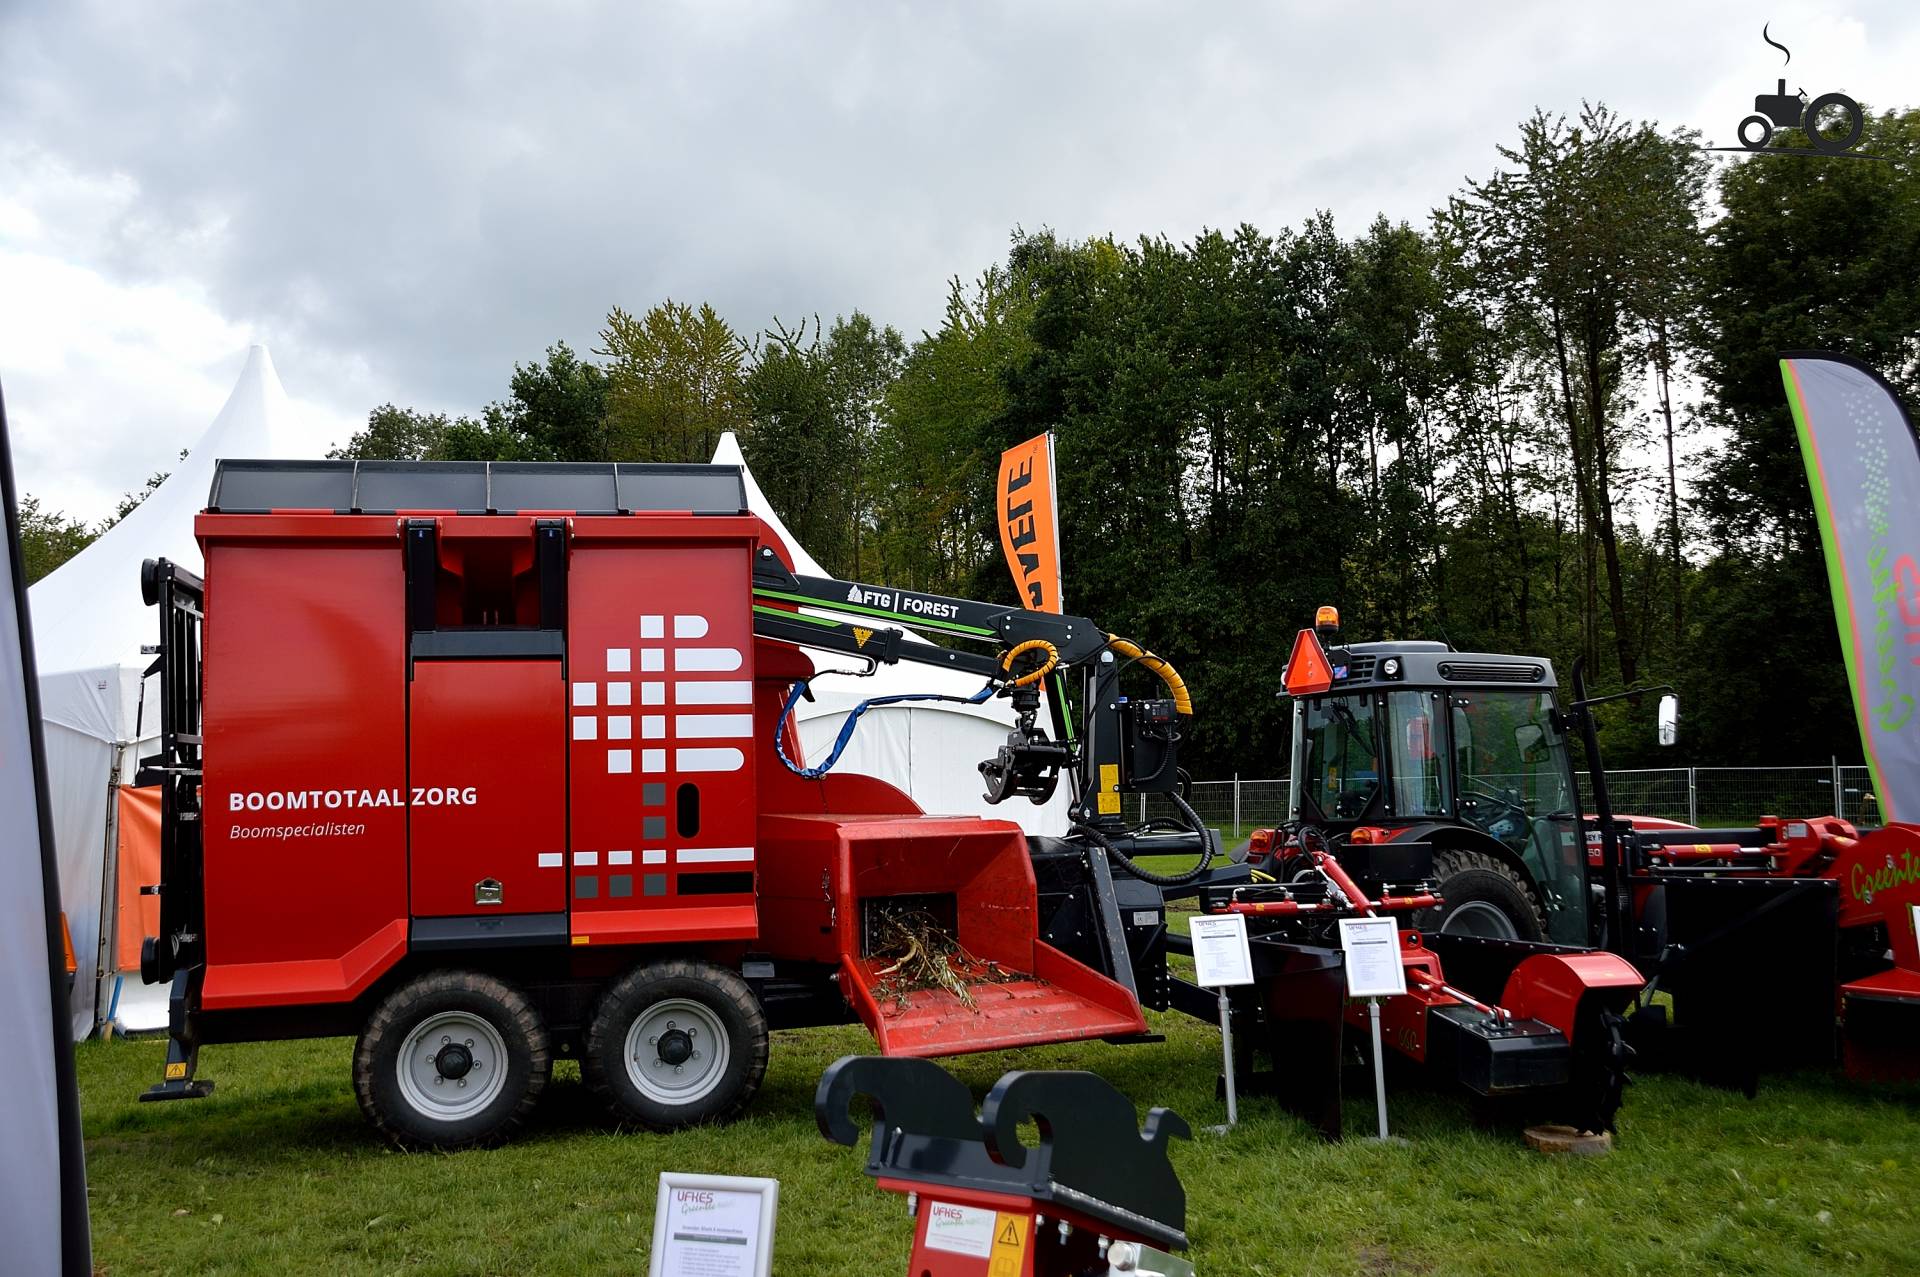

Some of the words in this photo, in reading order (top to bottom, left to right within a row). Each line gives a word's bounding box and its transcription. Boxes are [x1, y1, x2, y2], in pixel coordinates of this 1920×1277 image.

[863, 591, 891, 608] FTG
[903, 598, 959, 619] FOREST
[229, 822, 365, 840] Boomspecialisten
[677, 1190, 714, 1204] UFKES
[933, 1205, 963, 1219] UFKES
